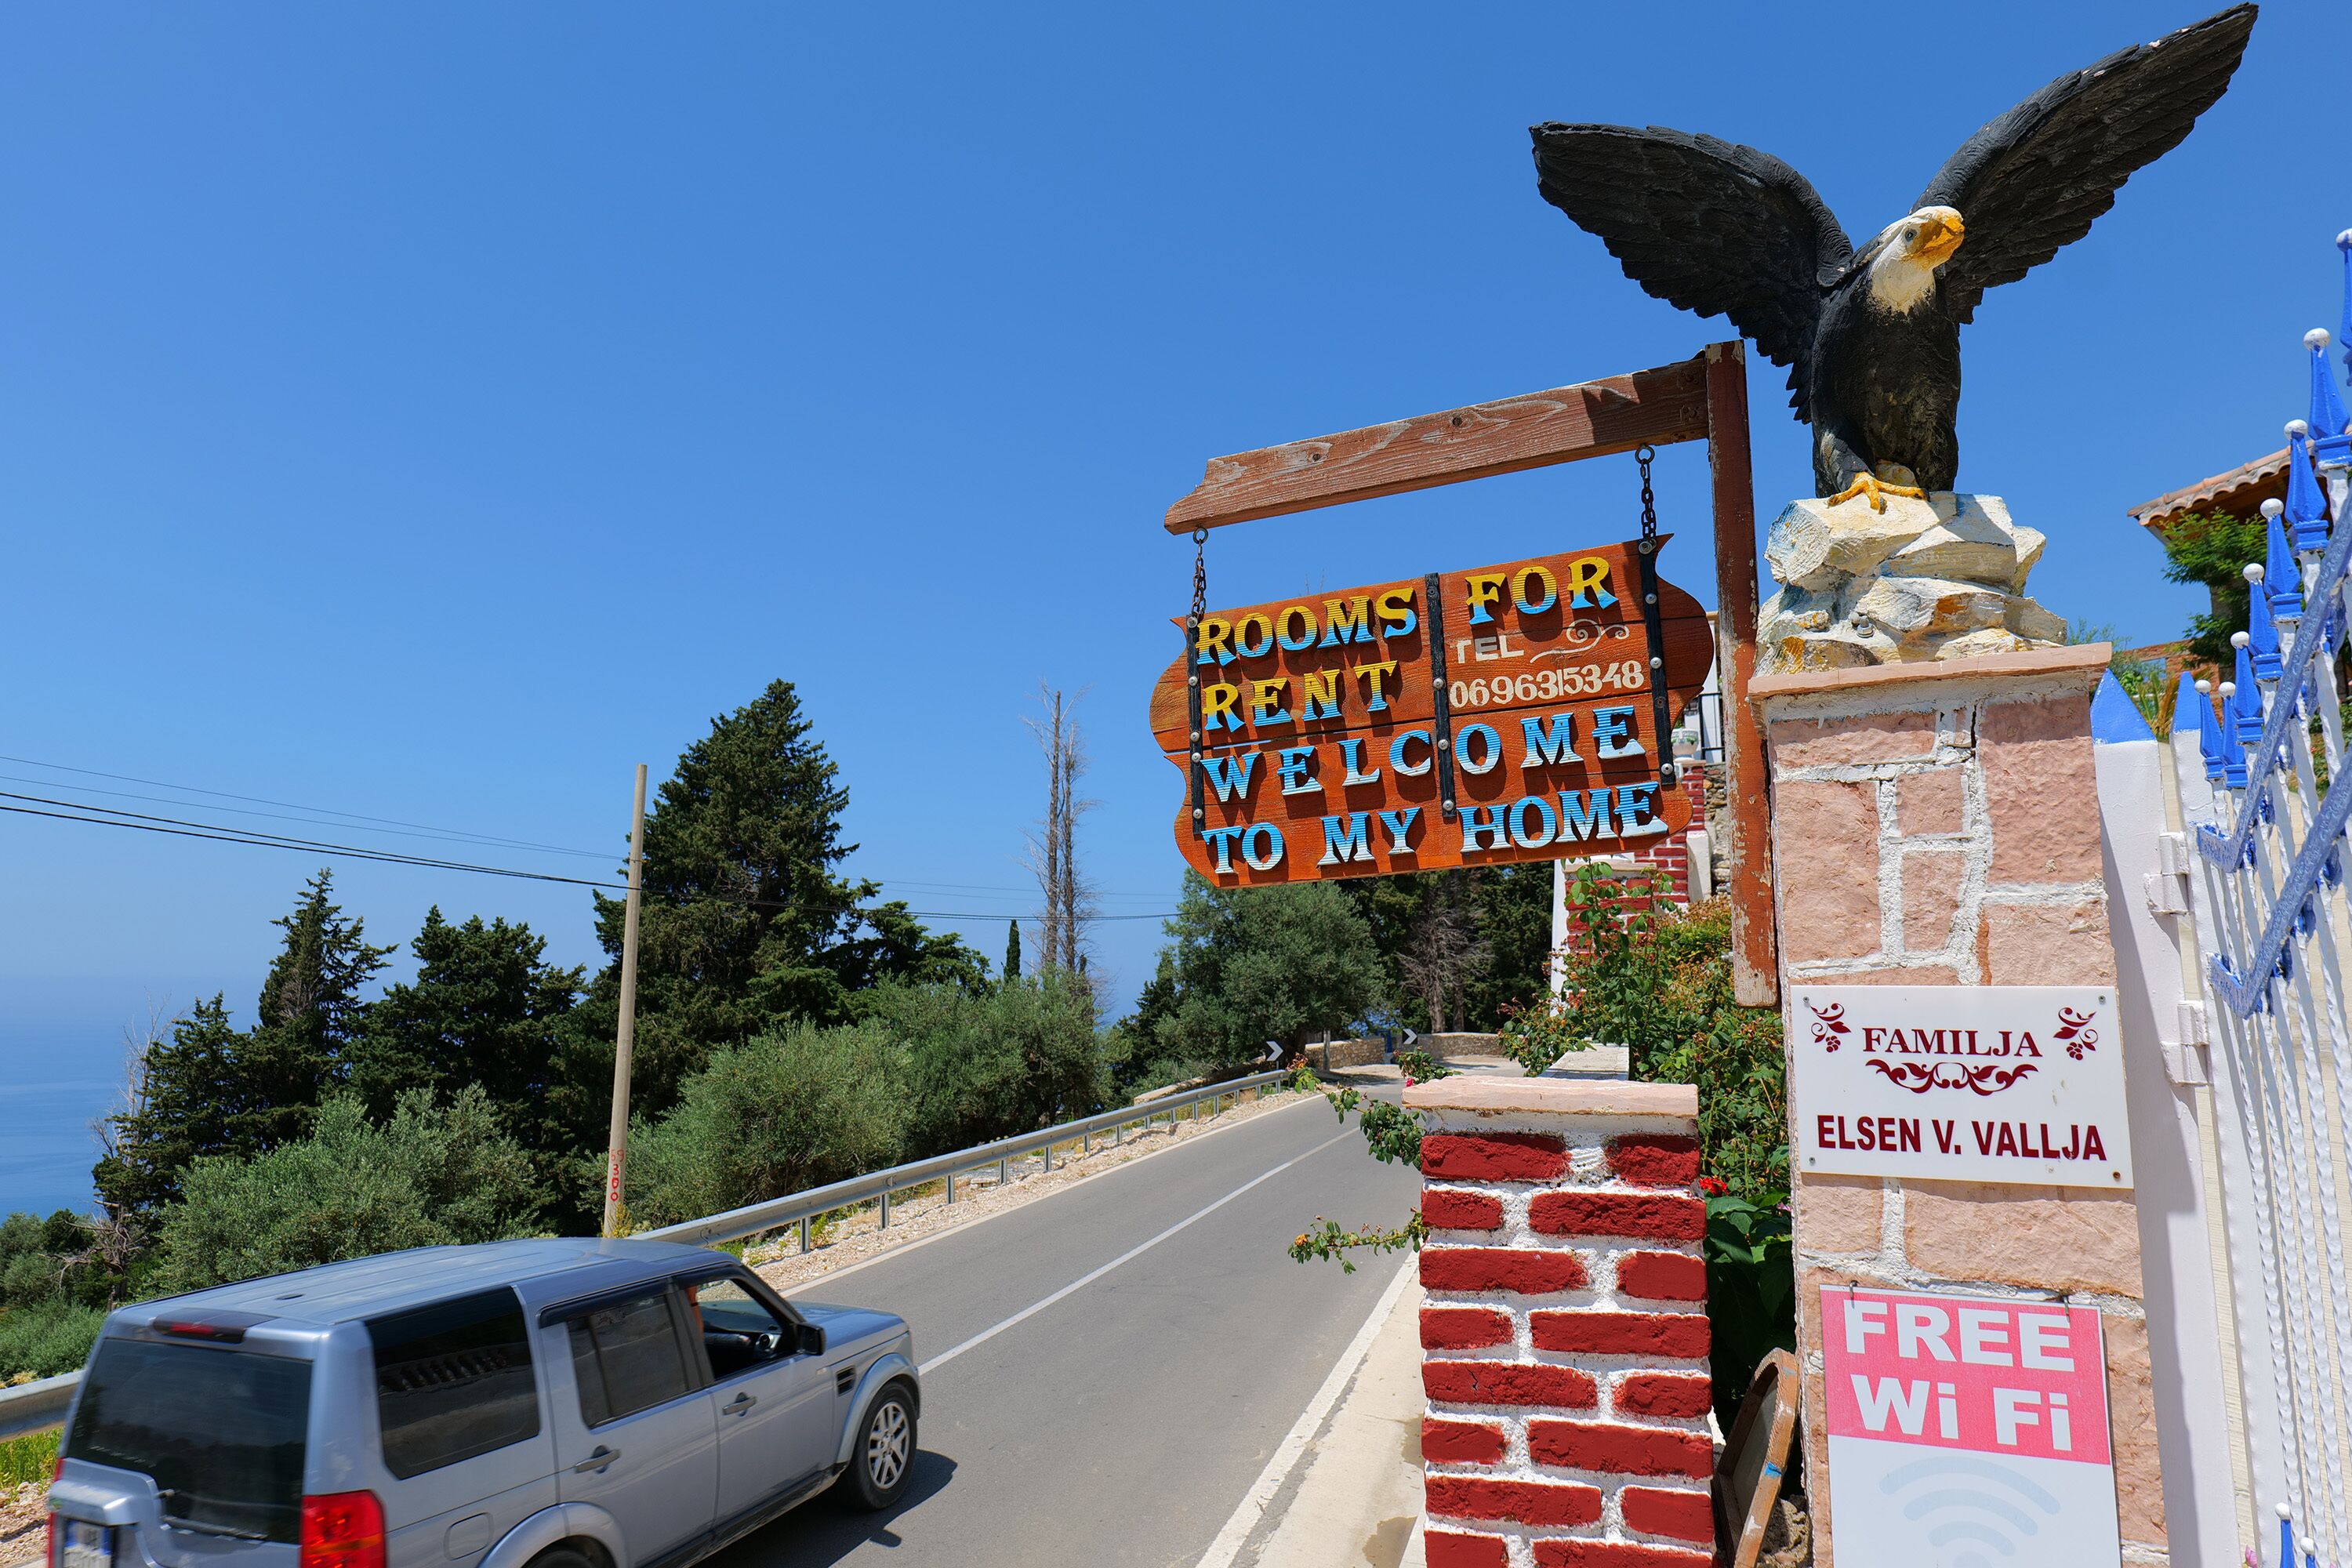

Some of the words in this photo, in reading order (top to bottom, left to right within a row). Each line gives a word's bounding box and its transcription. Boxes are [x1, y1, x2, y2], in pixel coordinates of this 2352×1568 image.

[1196, 587, 1417, 667] ROOMS
[1465, 556, 1617, 625] FOR
[1449, 660, 1645, 709] 0696315348
[1455, 635, 1525, 664] TEL
[1202, 660, 1399, 732] RENT
[1200, 705, 1646, 803] WELCOME
[1202, 822, 1286, 875] TO
[1318, 806, 1422, 866] MY
[1458, 781, 1669, 855] HOME
[1861, 1026, 2043, 1058] FAMILJA
[1817, 1114, 1922, 1153] ELSEN
[1932, 1119, 1962, 1156] V.
[1971, 1121, 2107, 1162] VALLJA
[1842, 1298, 2075, 1373] FREE
[1849, 1373, 1959, 1440] Wi
[1992, 1387, 2073, 1452] Fi
